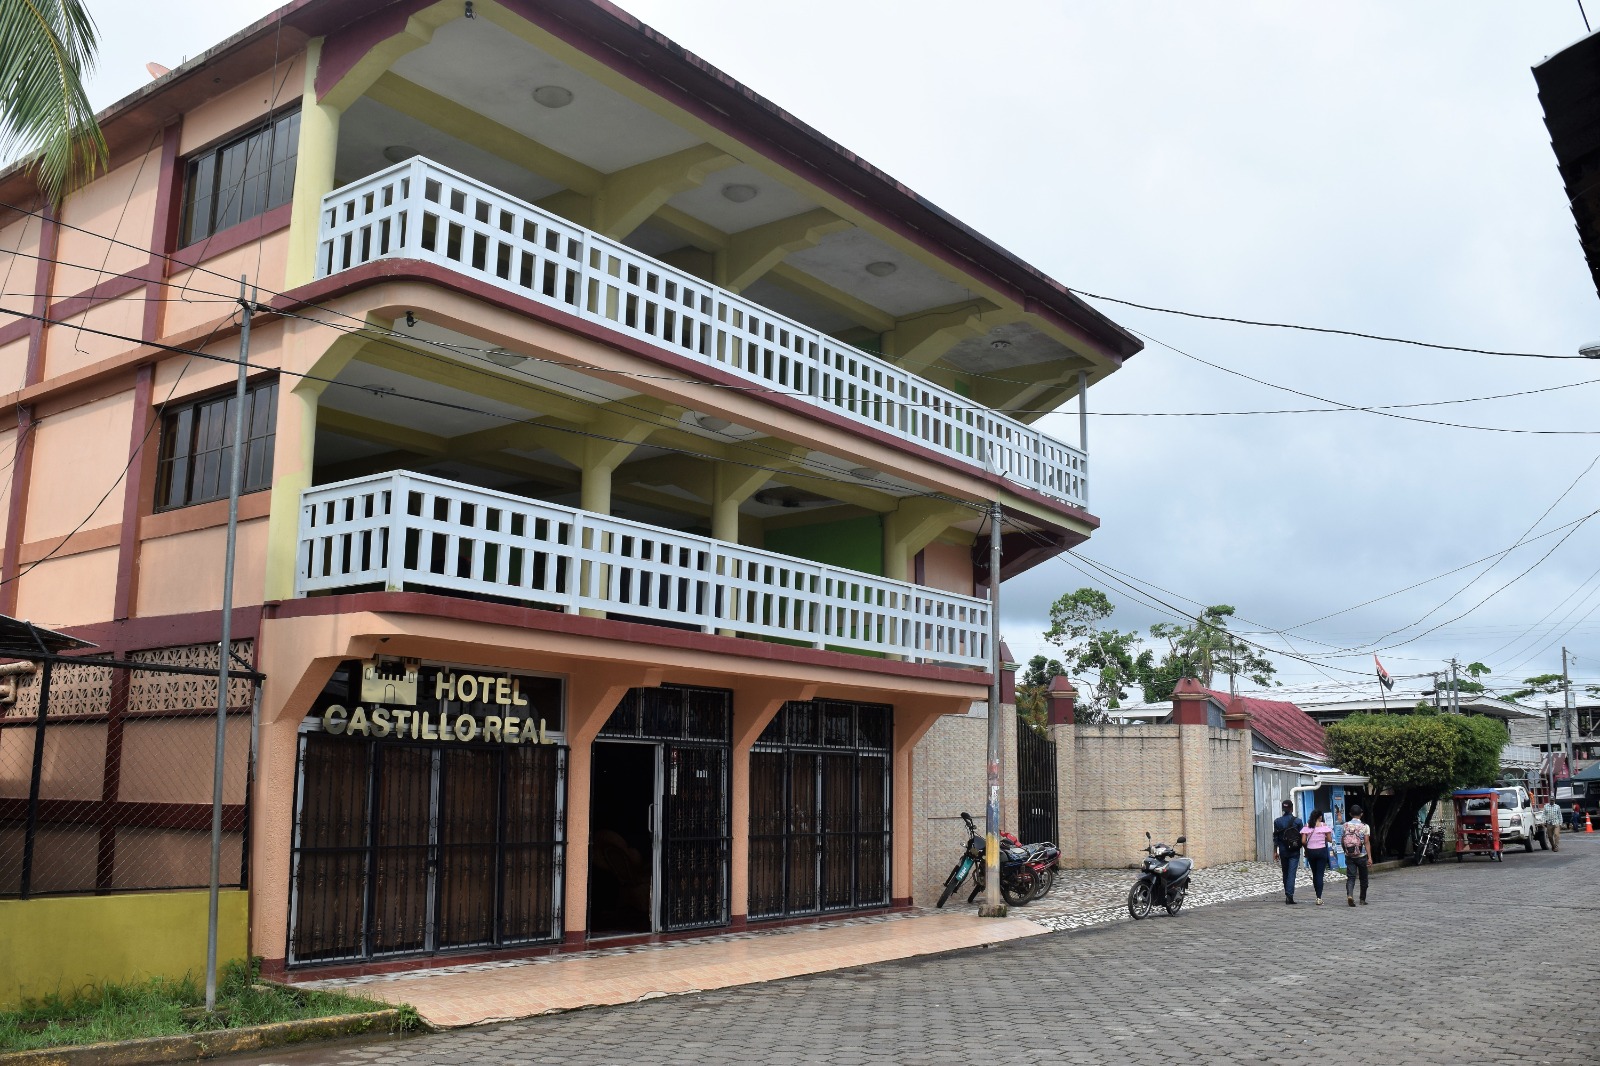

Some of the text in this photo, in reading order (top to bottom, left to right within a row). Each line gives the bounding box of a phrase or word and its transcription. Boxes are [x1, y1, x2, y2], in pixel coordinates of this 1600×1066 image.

[436, 672, 527, 705] HOTEL
[323, 704, 554, 744] CASTILLO REAL
